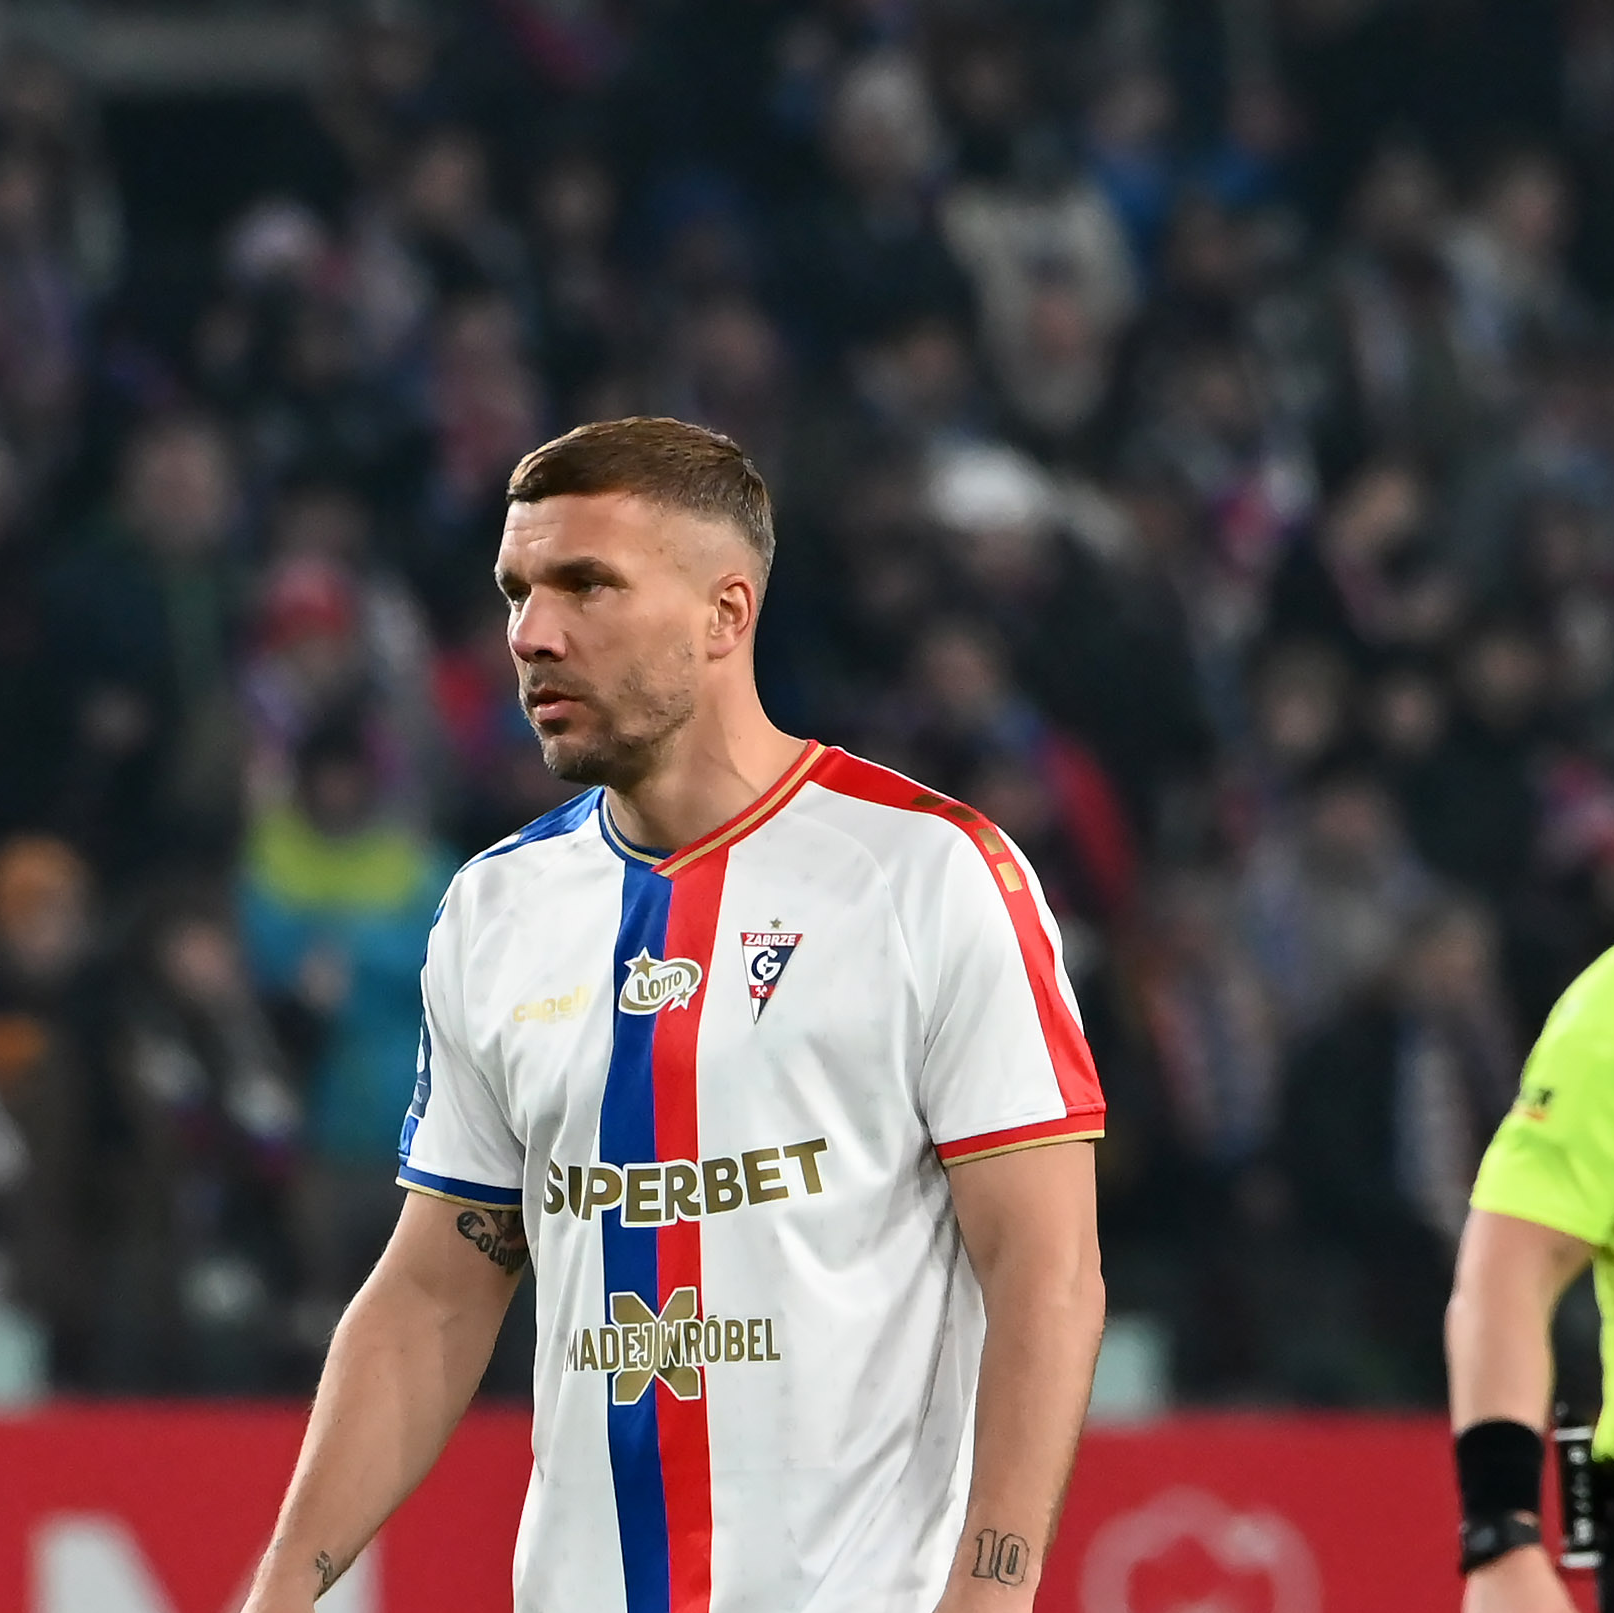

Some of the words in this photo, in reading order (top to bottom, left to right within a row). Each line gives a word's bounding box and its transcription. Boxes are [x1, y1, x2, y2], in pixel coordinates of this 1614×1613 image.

[744, 933, 797, 947] ZABRZE
[637, 970, 683, 1001] LOTTO
[971, 1528, 1030, 1587] 10
